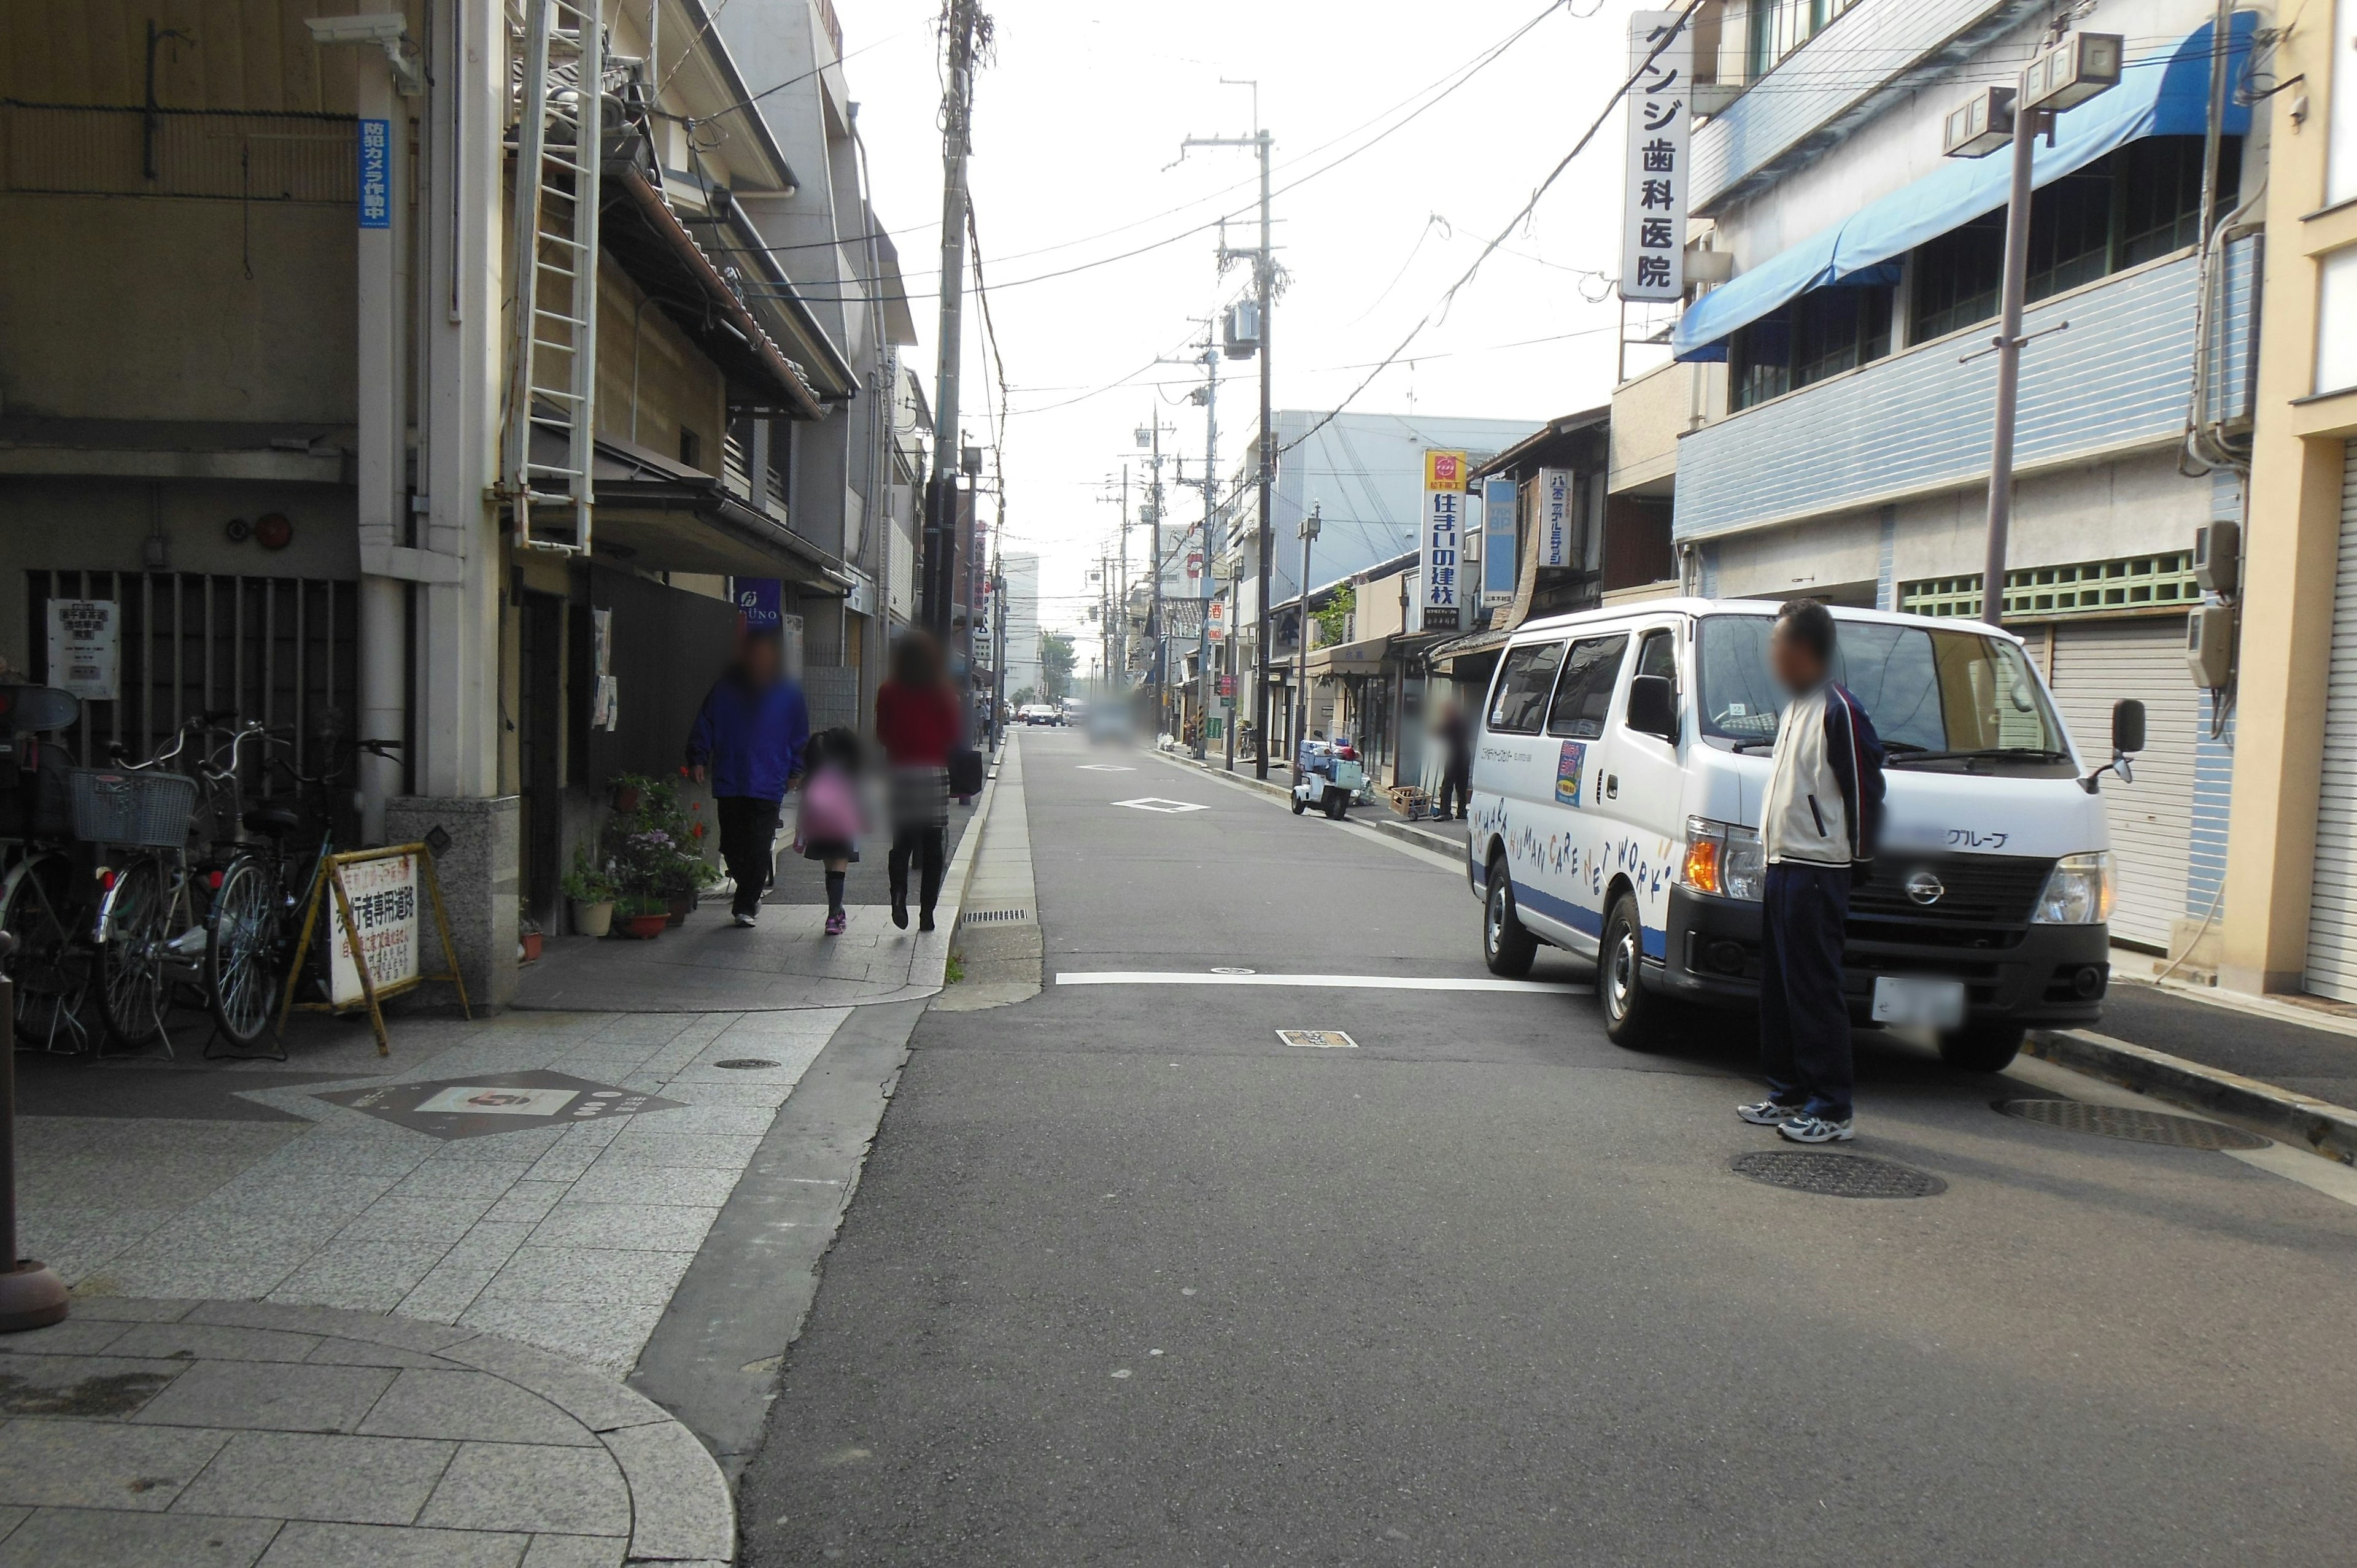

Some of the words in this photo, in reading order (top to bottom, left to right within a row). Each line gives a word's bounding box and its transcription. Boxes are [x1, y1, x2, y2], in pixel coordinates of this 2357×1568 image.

[363, 122, 385, 219] 防犯カメラ作動中
[1209, 604, 1221, 619] 酒
[1733, 705, 1741, 714] 2
[1510, 825, 1545, 874] HUMAN
[1550, 832, 1578, 878] CARE
